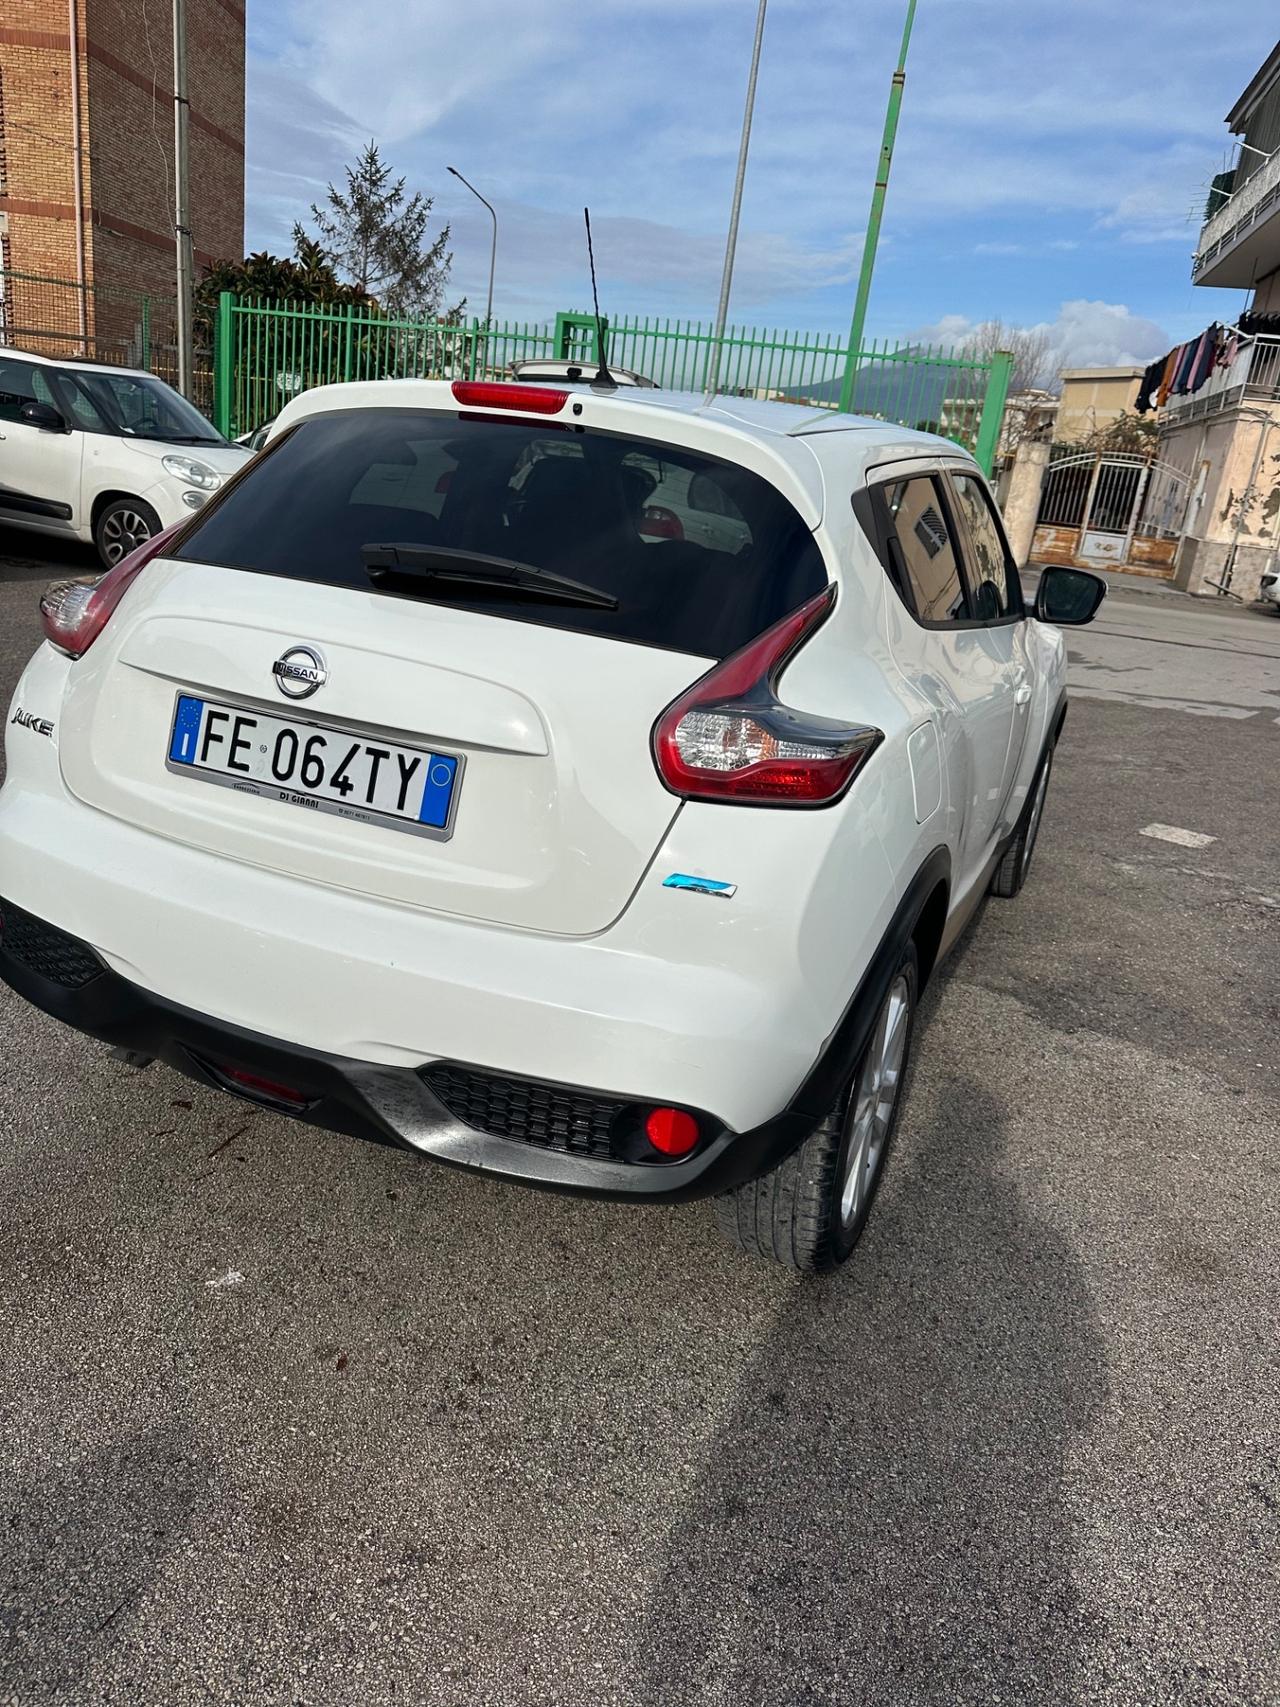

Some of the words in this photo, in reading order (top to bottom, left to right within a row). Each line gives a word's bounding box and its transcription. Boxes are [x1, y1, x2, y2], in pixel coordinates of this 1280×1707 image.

[278, 662, 318, 680] NISSAN
[11, 707, 55, 738] JUKE
[291, 795, 319, 808] GIANNI
